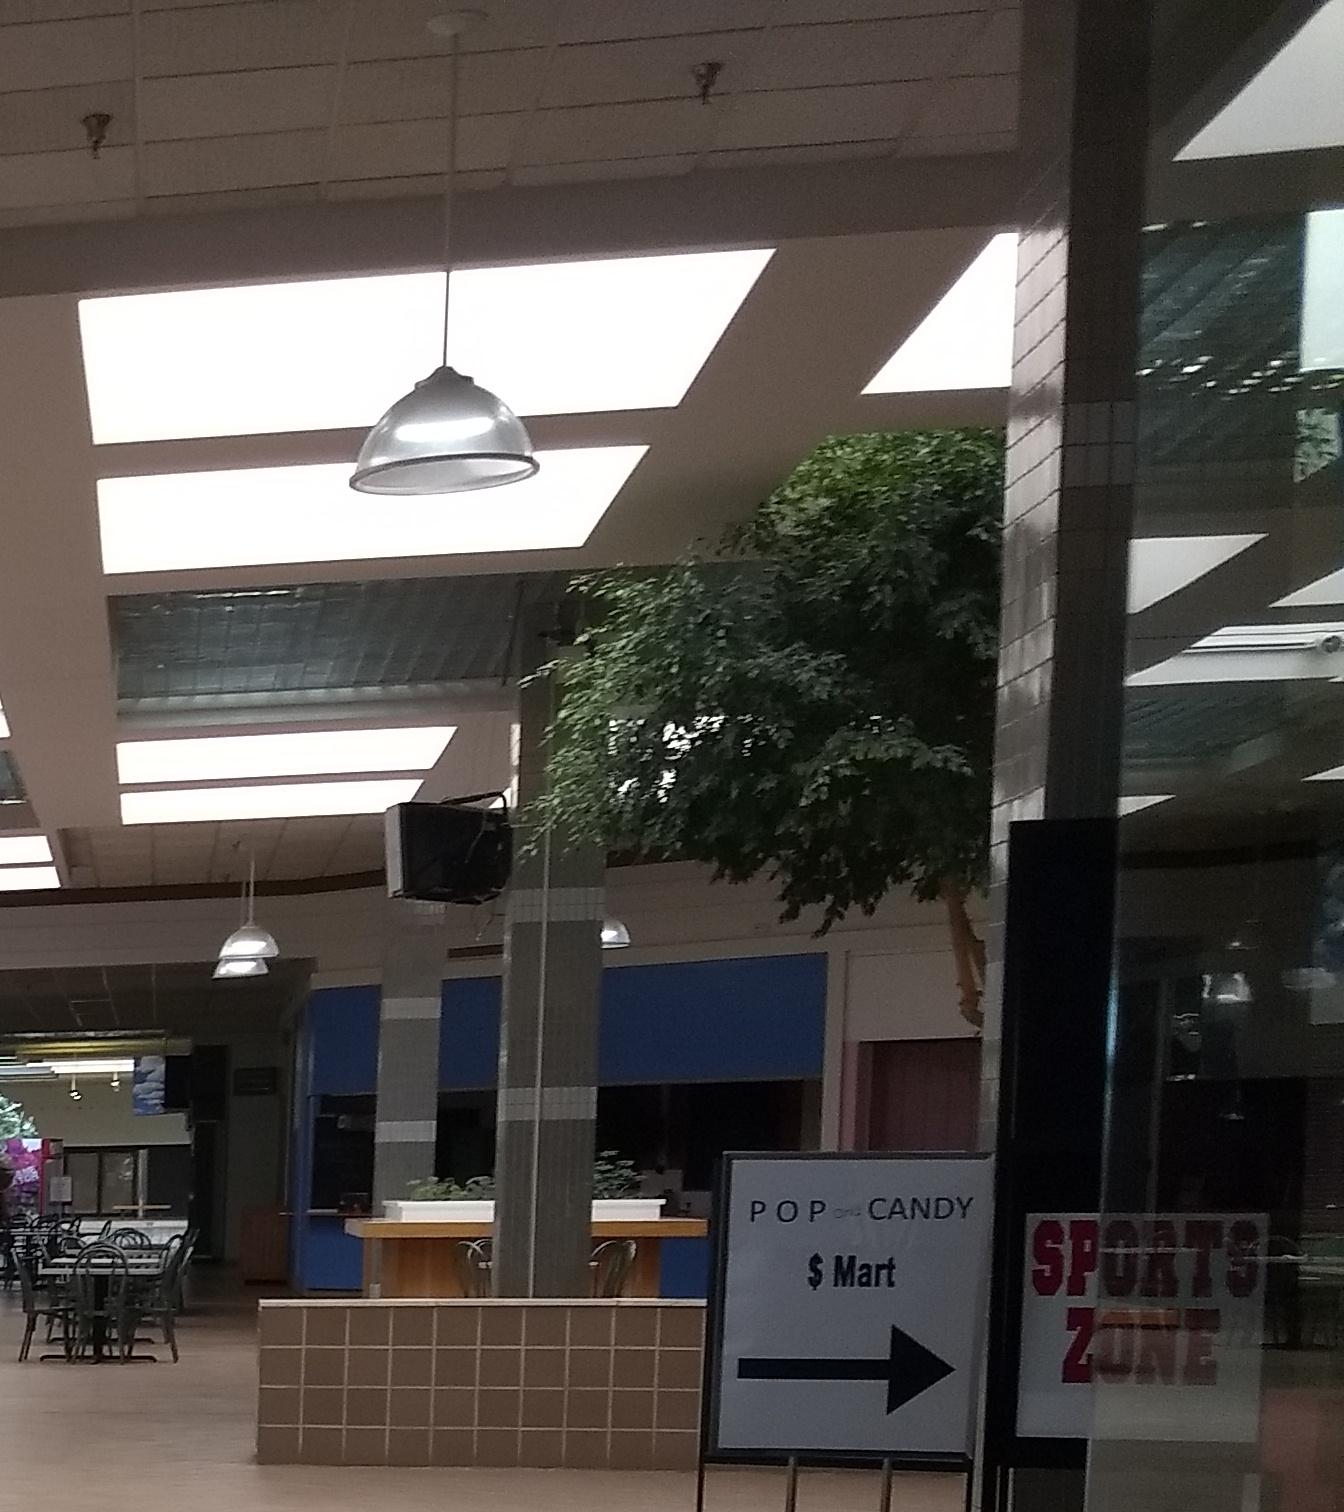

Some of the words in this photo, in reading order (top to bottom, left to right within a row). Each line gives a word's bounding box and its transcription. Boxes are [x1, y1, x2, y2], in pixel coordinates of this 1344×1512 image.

[869, 1197, 974, 1221] CANDY
[808, 1253, 823, 1290] $
[833, 1255, 896, 1288] Mart
[1032, 1219, 1261, 1298] SPORTS
[1062, 1307, 1221, 1386] ZONE
